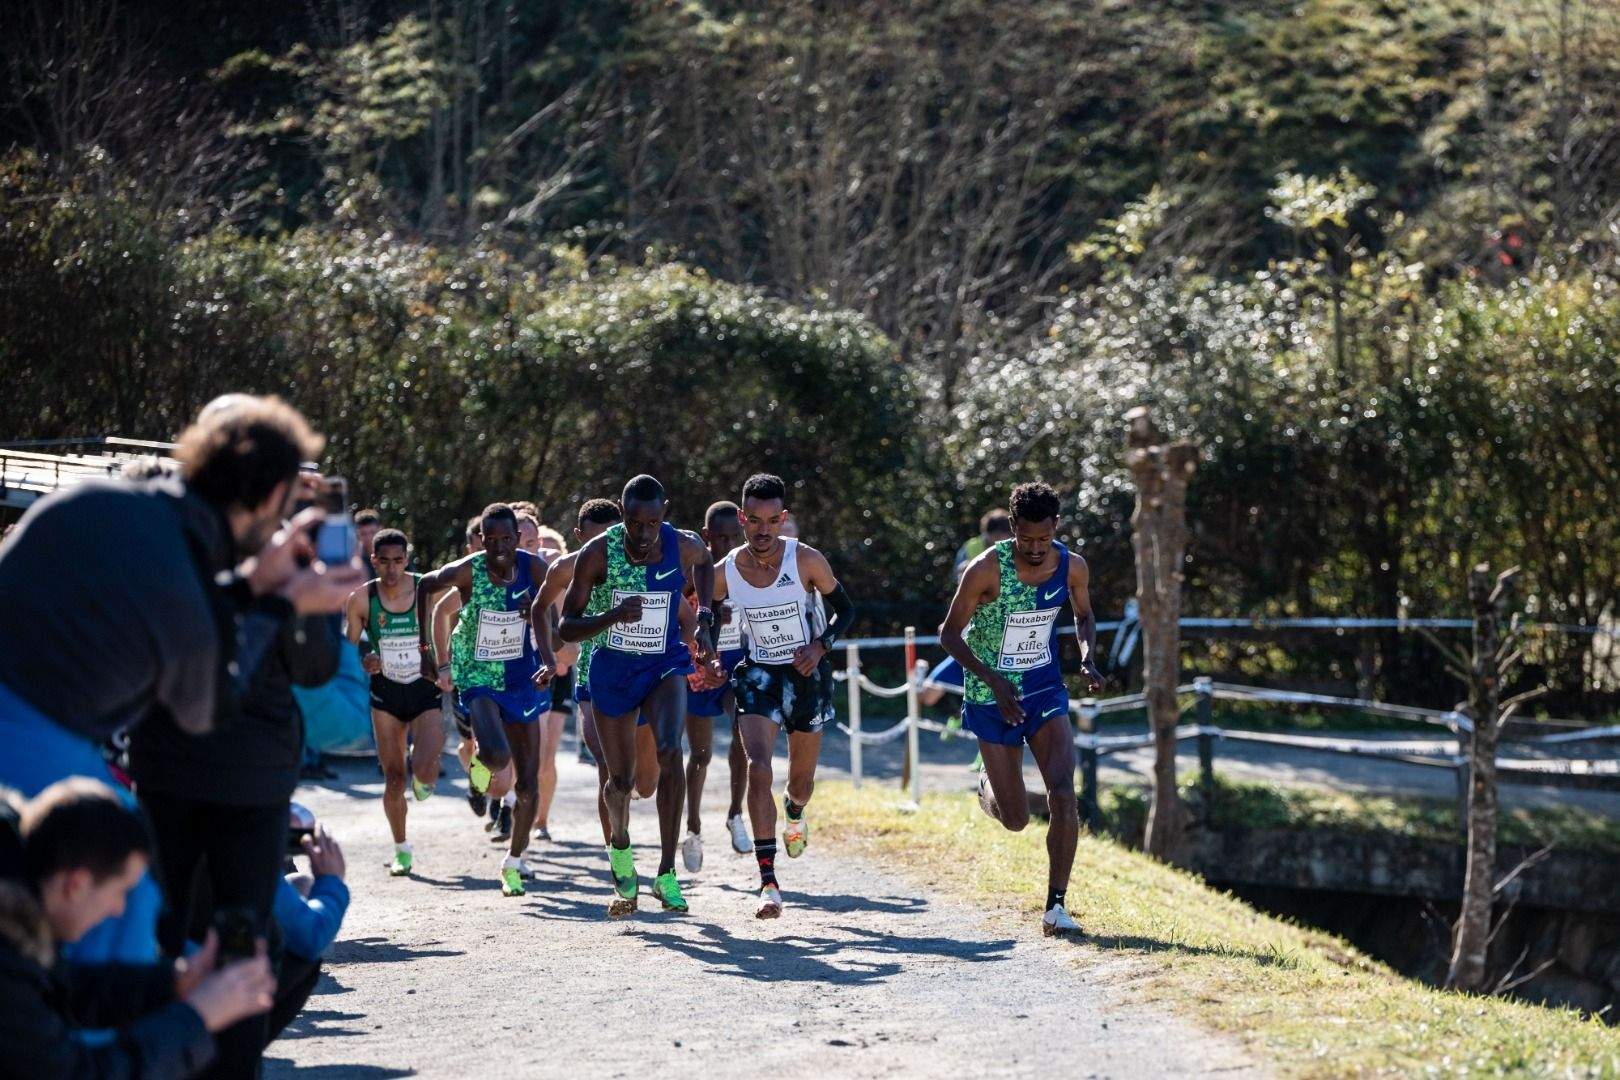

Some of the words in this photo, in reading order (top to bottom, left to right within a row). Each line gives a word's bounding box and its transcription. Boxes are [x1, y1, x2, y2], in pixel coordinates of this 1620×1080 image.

[748, 605, 797, 619] kutxabank
[616, 621, 661, 635] Chelimo
[772, 624, 780, 632] 9
[1028, 630, 1037, 639] 2
[624, 640, 661, 648] DANOBAT
[760, 633, 794, 646] Worku
[1016, 640, 1043, 652] Kifle
[398, 652, 409, 660] 11
[490, 648, 520, 656] DANOBAT
